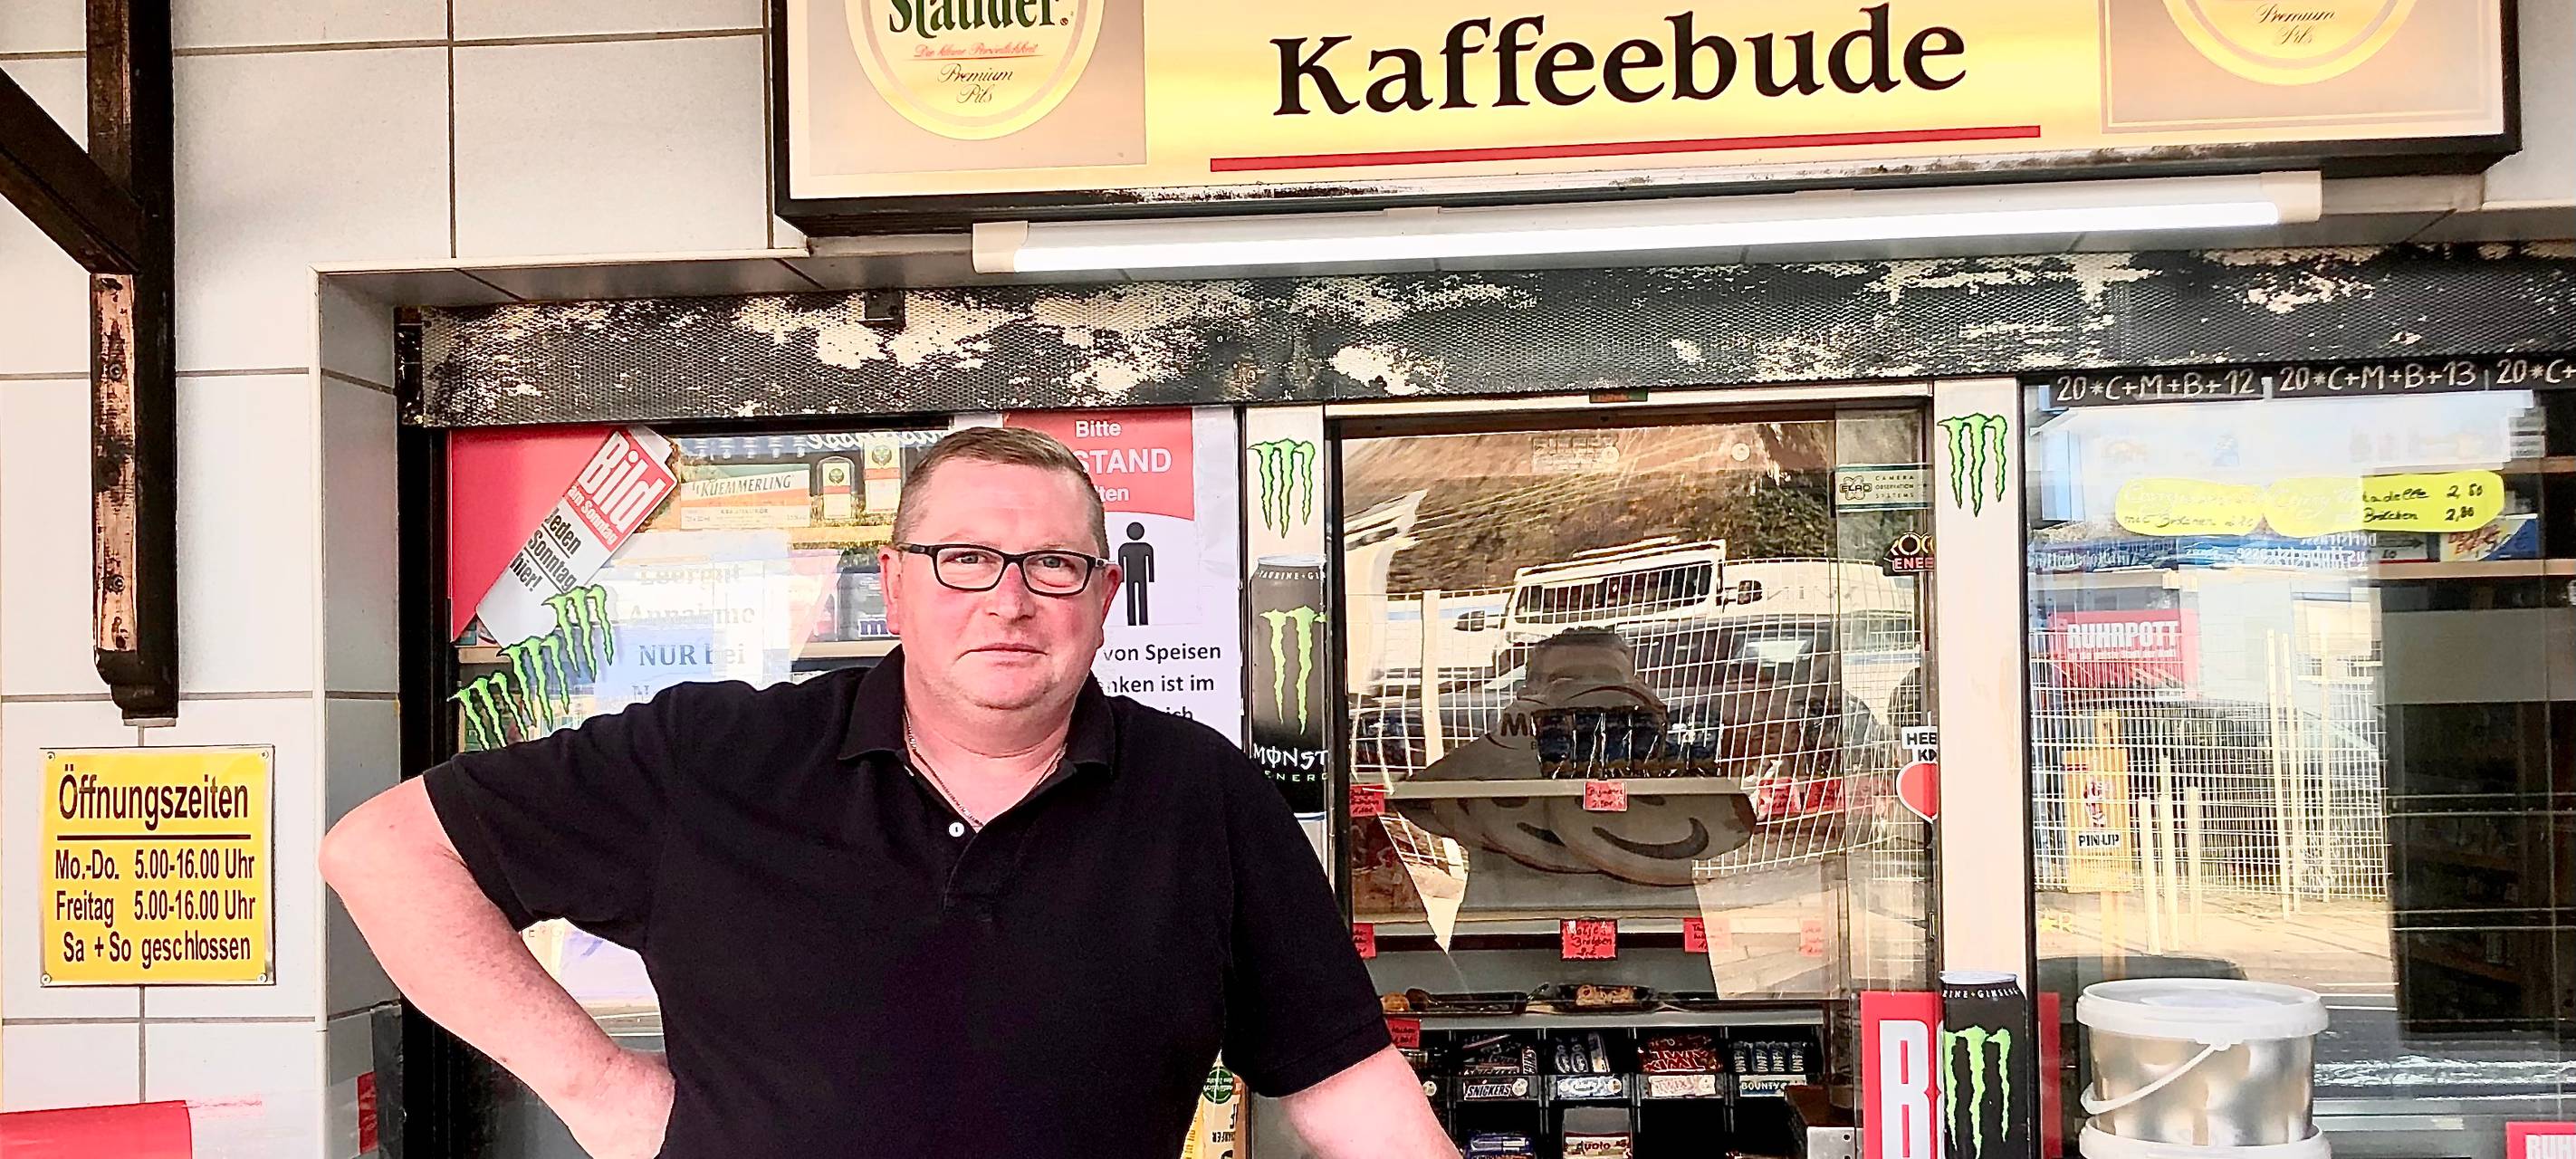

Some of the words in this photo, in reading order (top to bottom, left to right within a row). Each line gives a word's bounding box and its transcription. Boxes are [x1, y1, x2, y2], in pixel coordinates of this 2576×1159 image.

[938, 62, 1013, 82] Premium
[1269, 3, 1968, 116] Kaffeebude
[956, 83, 995, 103] Pils
[1075, 419, 1123, 438] Bitte
[577, 430, 667, 534] Bild
[509, 551, 543, 592] hier!
[528, 531, 578, 593] Sonntag
[2067, 620, 2179, 649] RUHRPOTT
[639, 644, 697, 666] NUR
[1104, 647, 1139, 661] von
[1145, 643, 1221, 664] Speisen
[1161, 675, 1183, 692] ist
[1191, 674, 1214, 691] im
[59, 764, 249, 830] Öffnungszeiten
[55, 848, 120, 880] Mo.-Do.
[135, 848, 219, 879] 5.00-16.00
[225, 848, 255, 879] Uhr
[56, 890, 115, 928] Freitag
[134, 889, 219, 921] 5.00-16.00
[225, 889, 256, 920] Uhr
[63, 931, 84, 962] Sa
[110, 931, 131, 962] So
[142, 930, 251, 969] geschlossen
[1467, 1084, 1511, 1097] SNICKERS
[1740, 1081, 1779, 1090] BOUNTY
